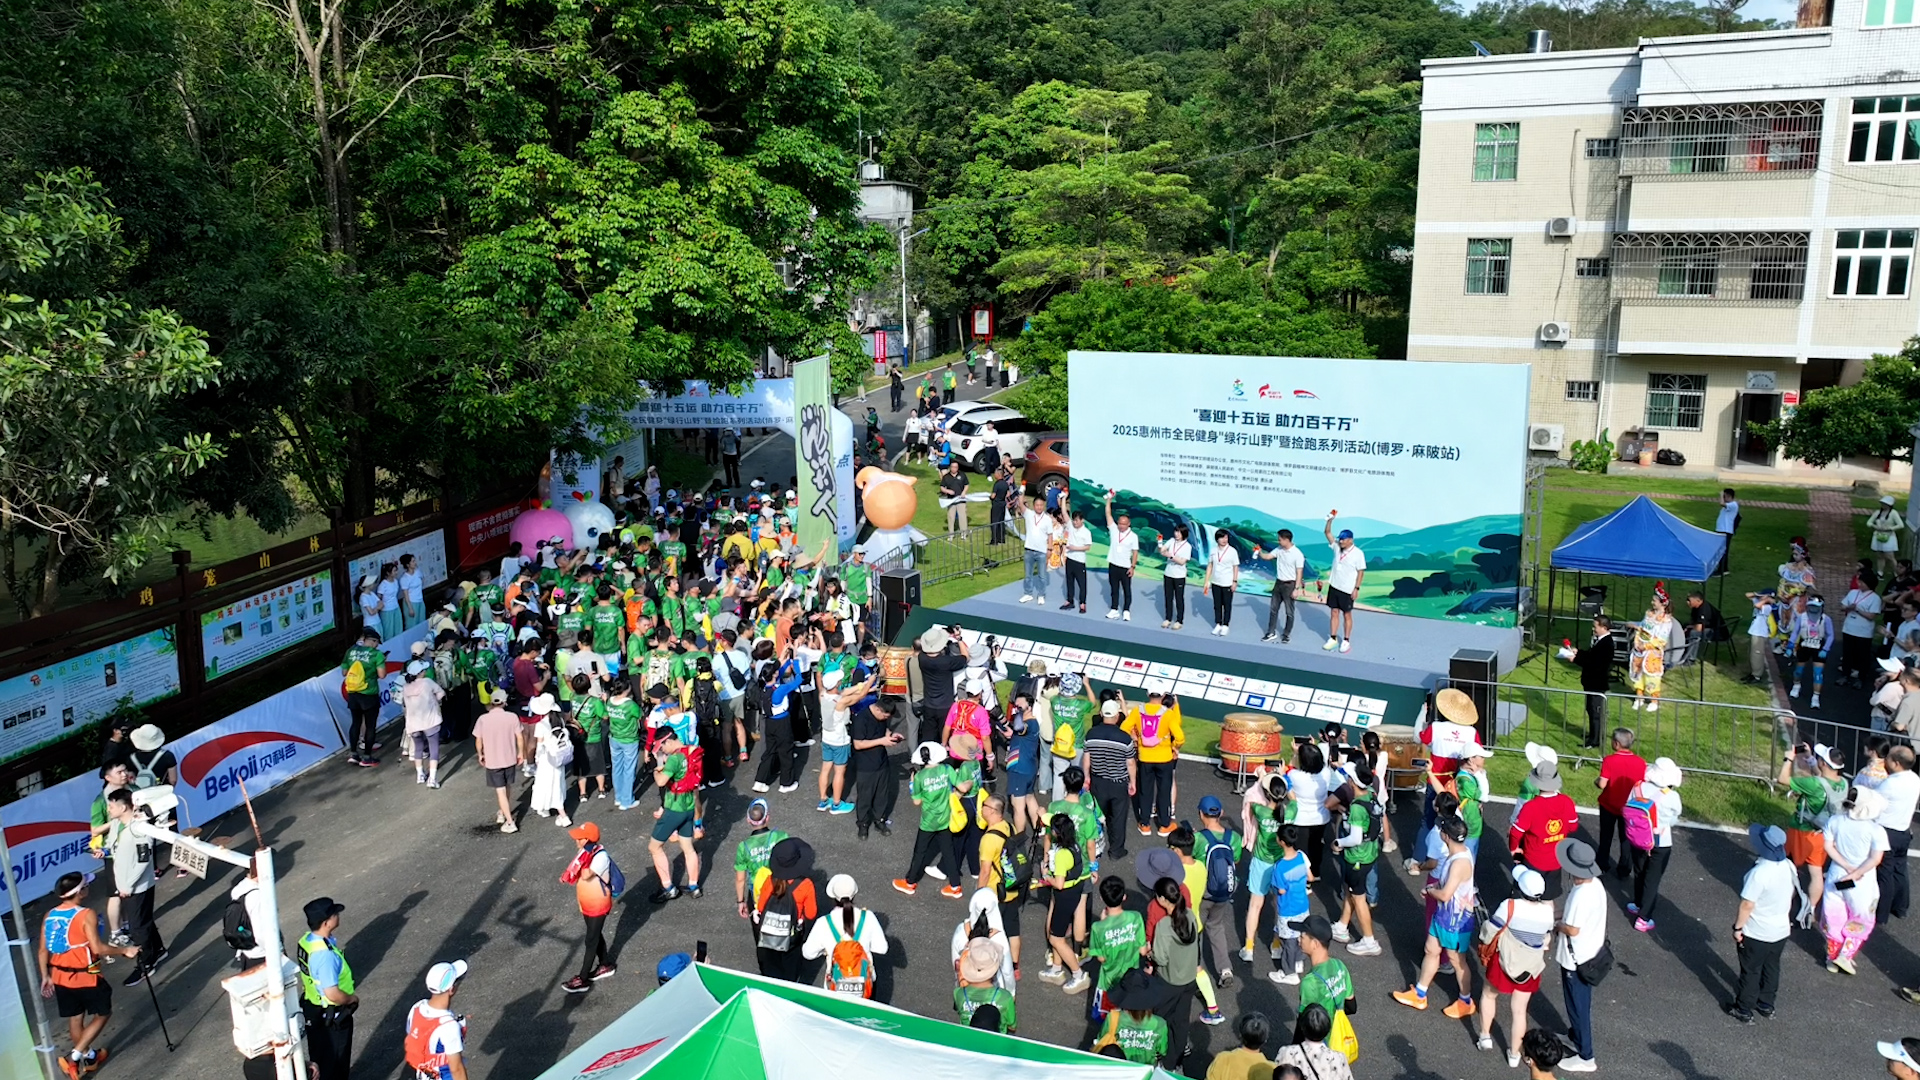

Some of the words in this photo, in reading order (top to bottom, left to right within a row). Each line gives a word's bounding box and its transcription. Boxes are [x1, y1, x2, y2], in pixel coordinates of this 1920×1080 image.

[1193, 408, 1270, 426] "喜迎十五运
[1275, 413, 1359, 431] 助力百千万"
[204, 754, 258, 801] Bekoji
[174, 844, 206, 873] 视频监控
